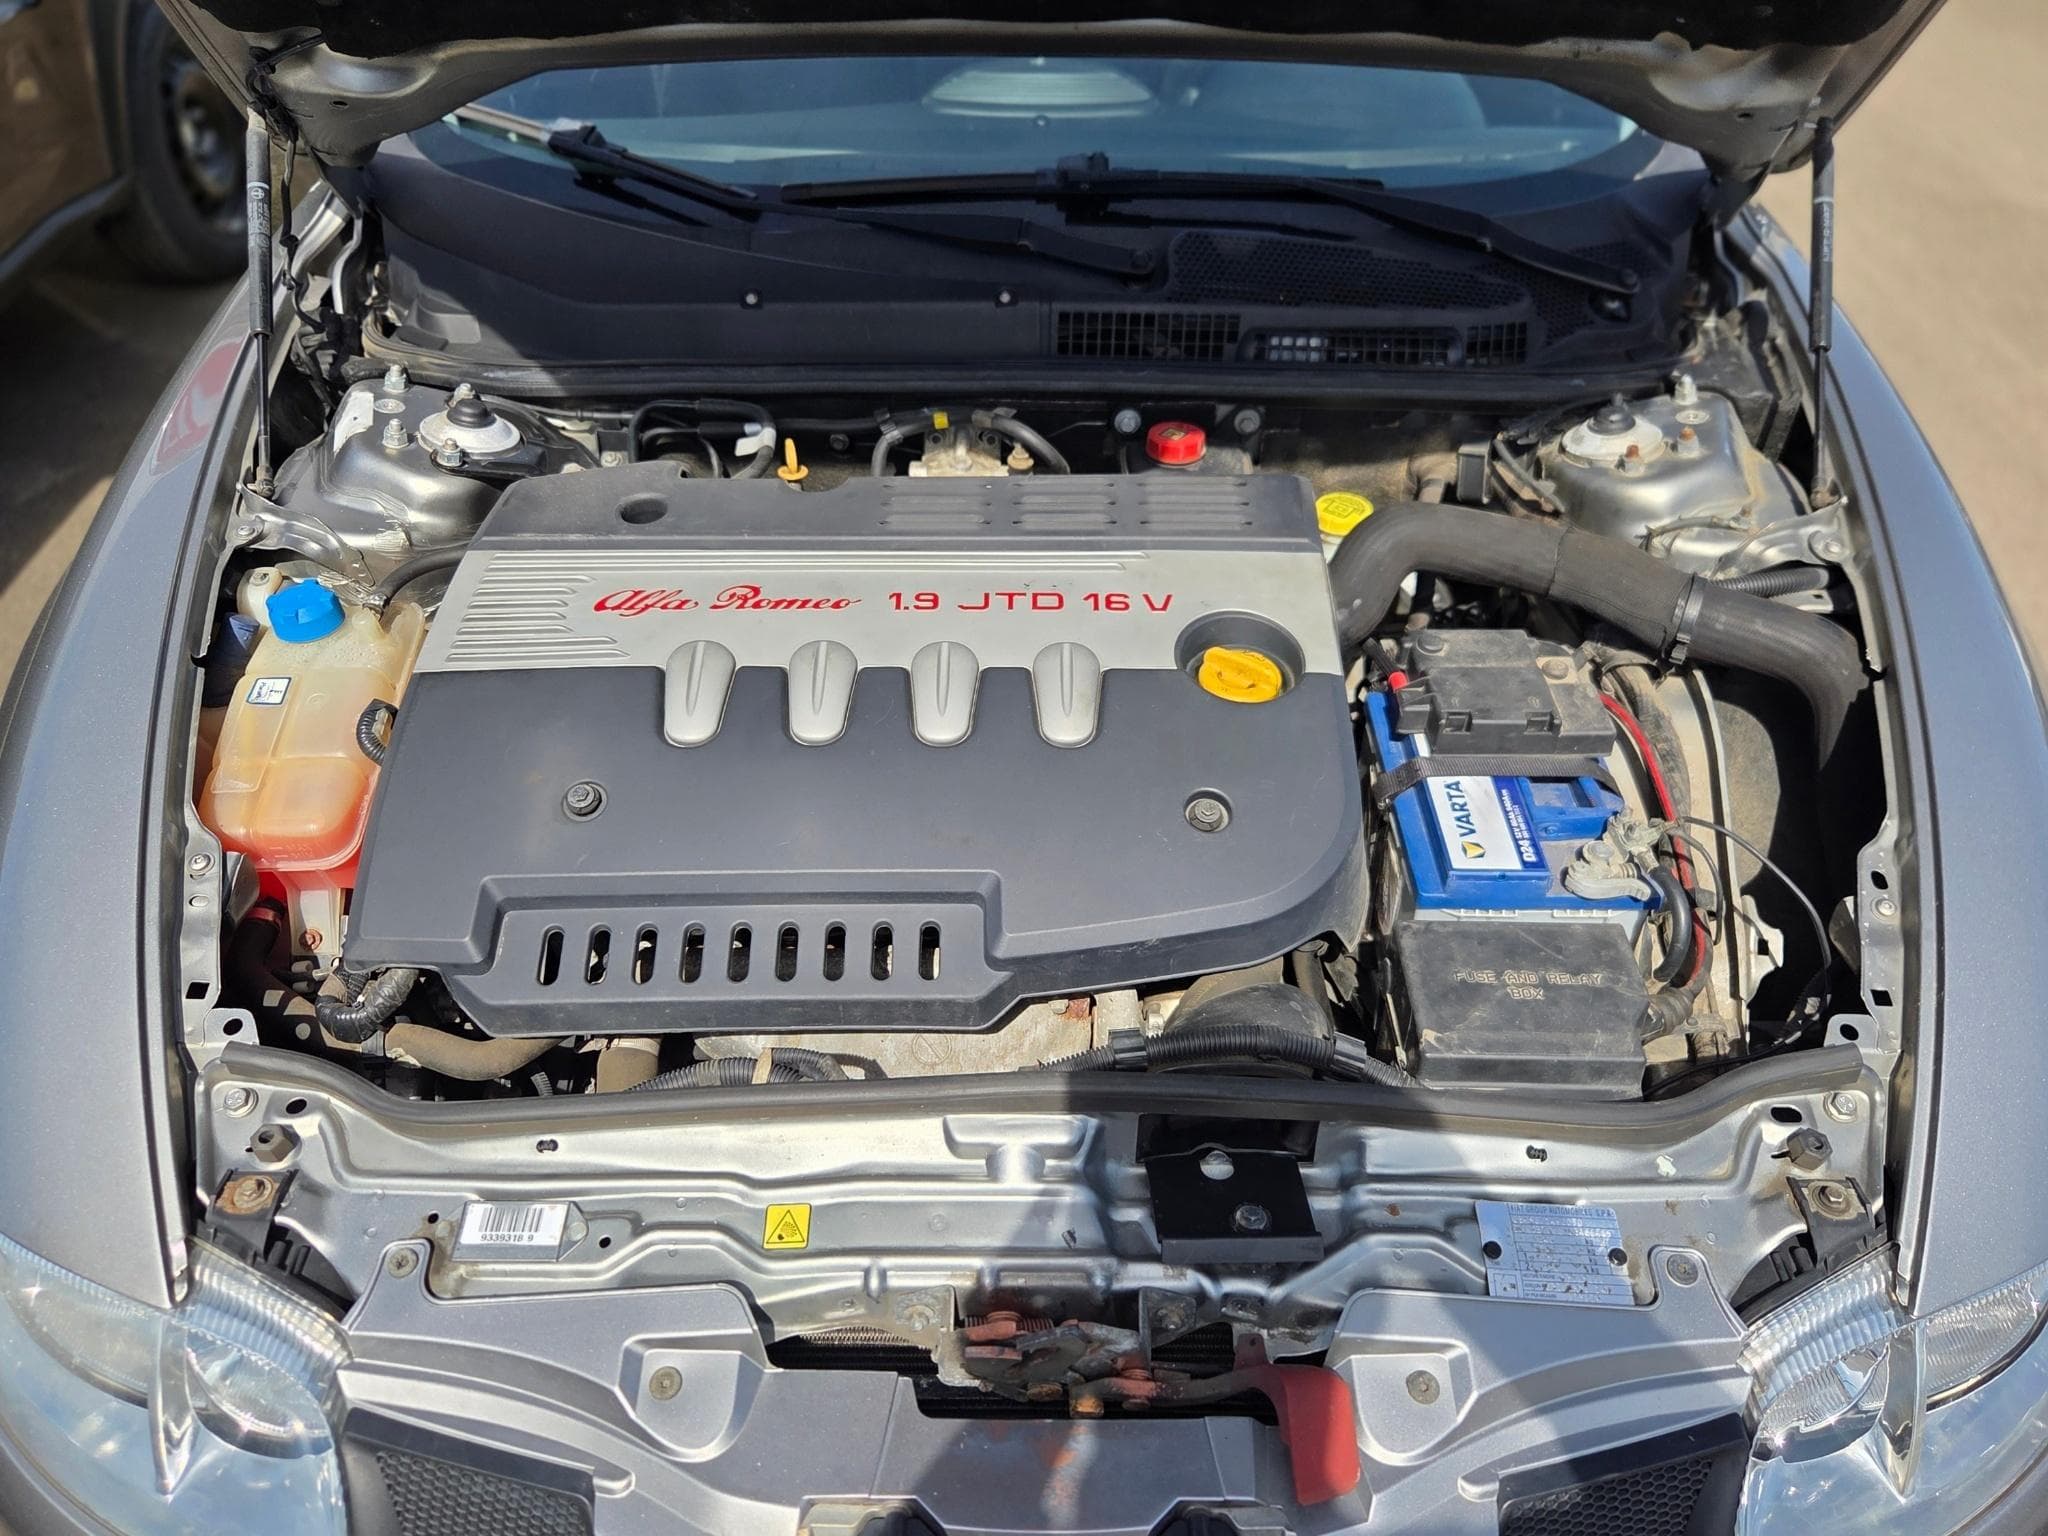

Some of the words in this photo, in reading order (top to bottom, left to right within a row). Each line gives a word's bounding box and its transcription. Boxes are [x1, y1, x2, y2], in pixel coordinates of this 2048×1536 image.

[593, 589, 699, 618] Alfa
[709, 585, 861, 611] Romeo
[888, 592, 940, 611] 1.9
[957, 592, 1065, 611] JTD
[1082, 592, 1131, 612] 16
[1142, 593, 1174, 612] V
[1444, 781, 1476, 837] VARTA
[1518, 840, 1537, 862] D24
[1454, 969, 1498, 984] FUSE
[1503, 969, 1539, 984] AND
[1546, 971, 1602, 985] RELAY
[1506, 986, 1545, 1000] BOX
